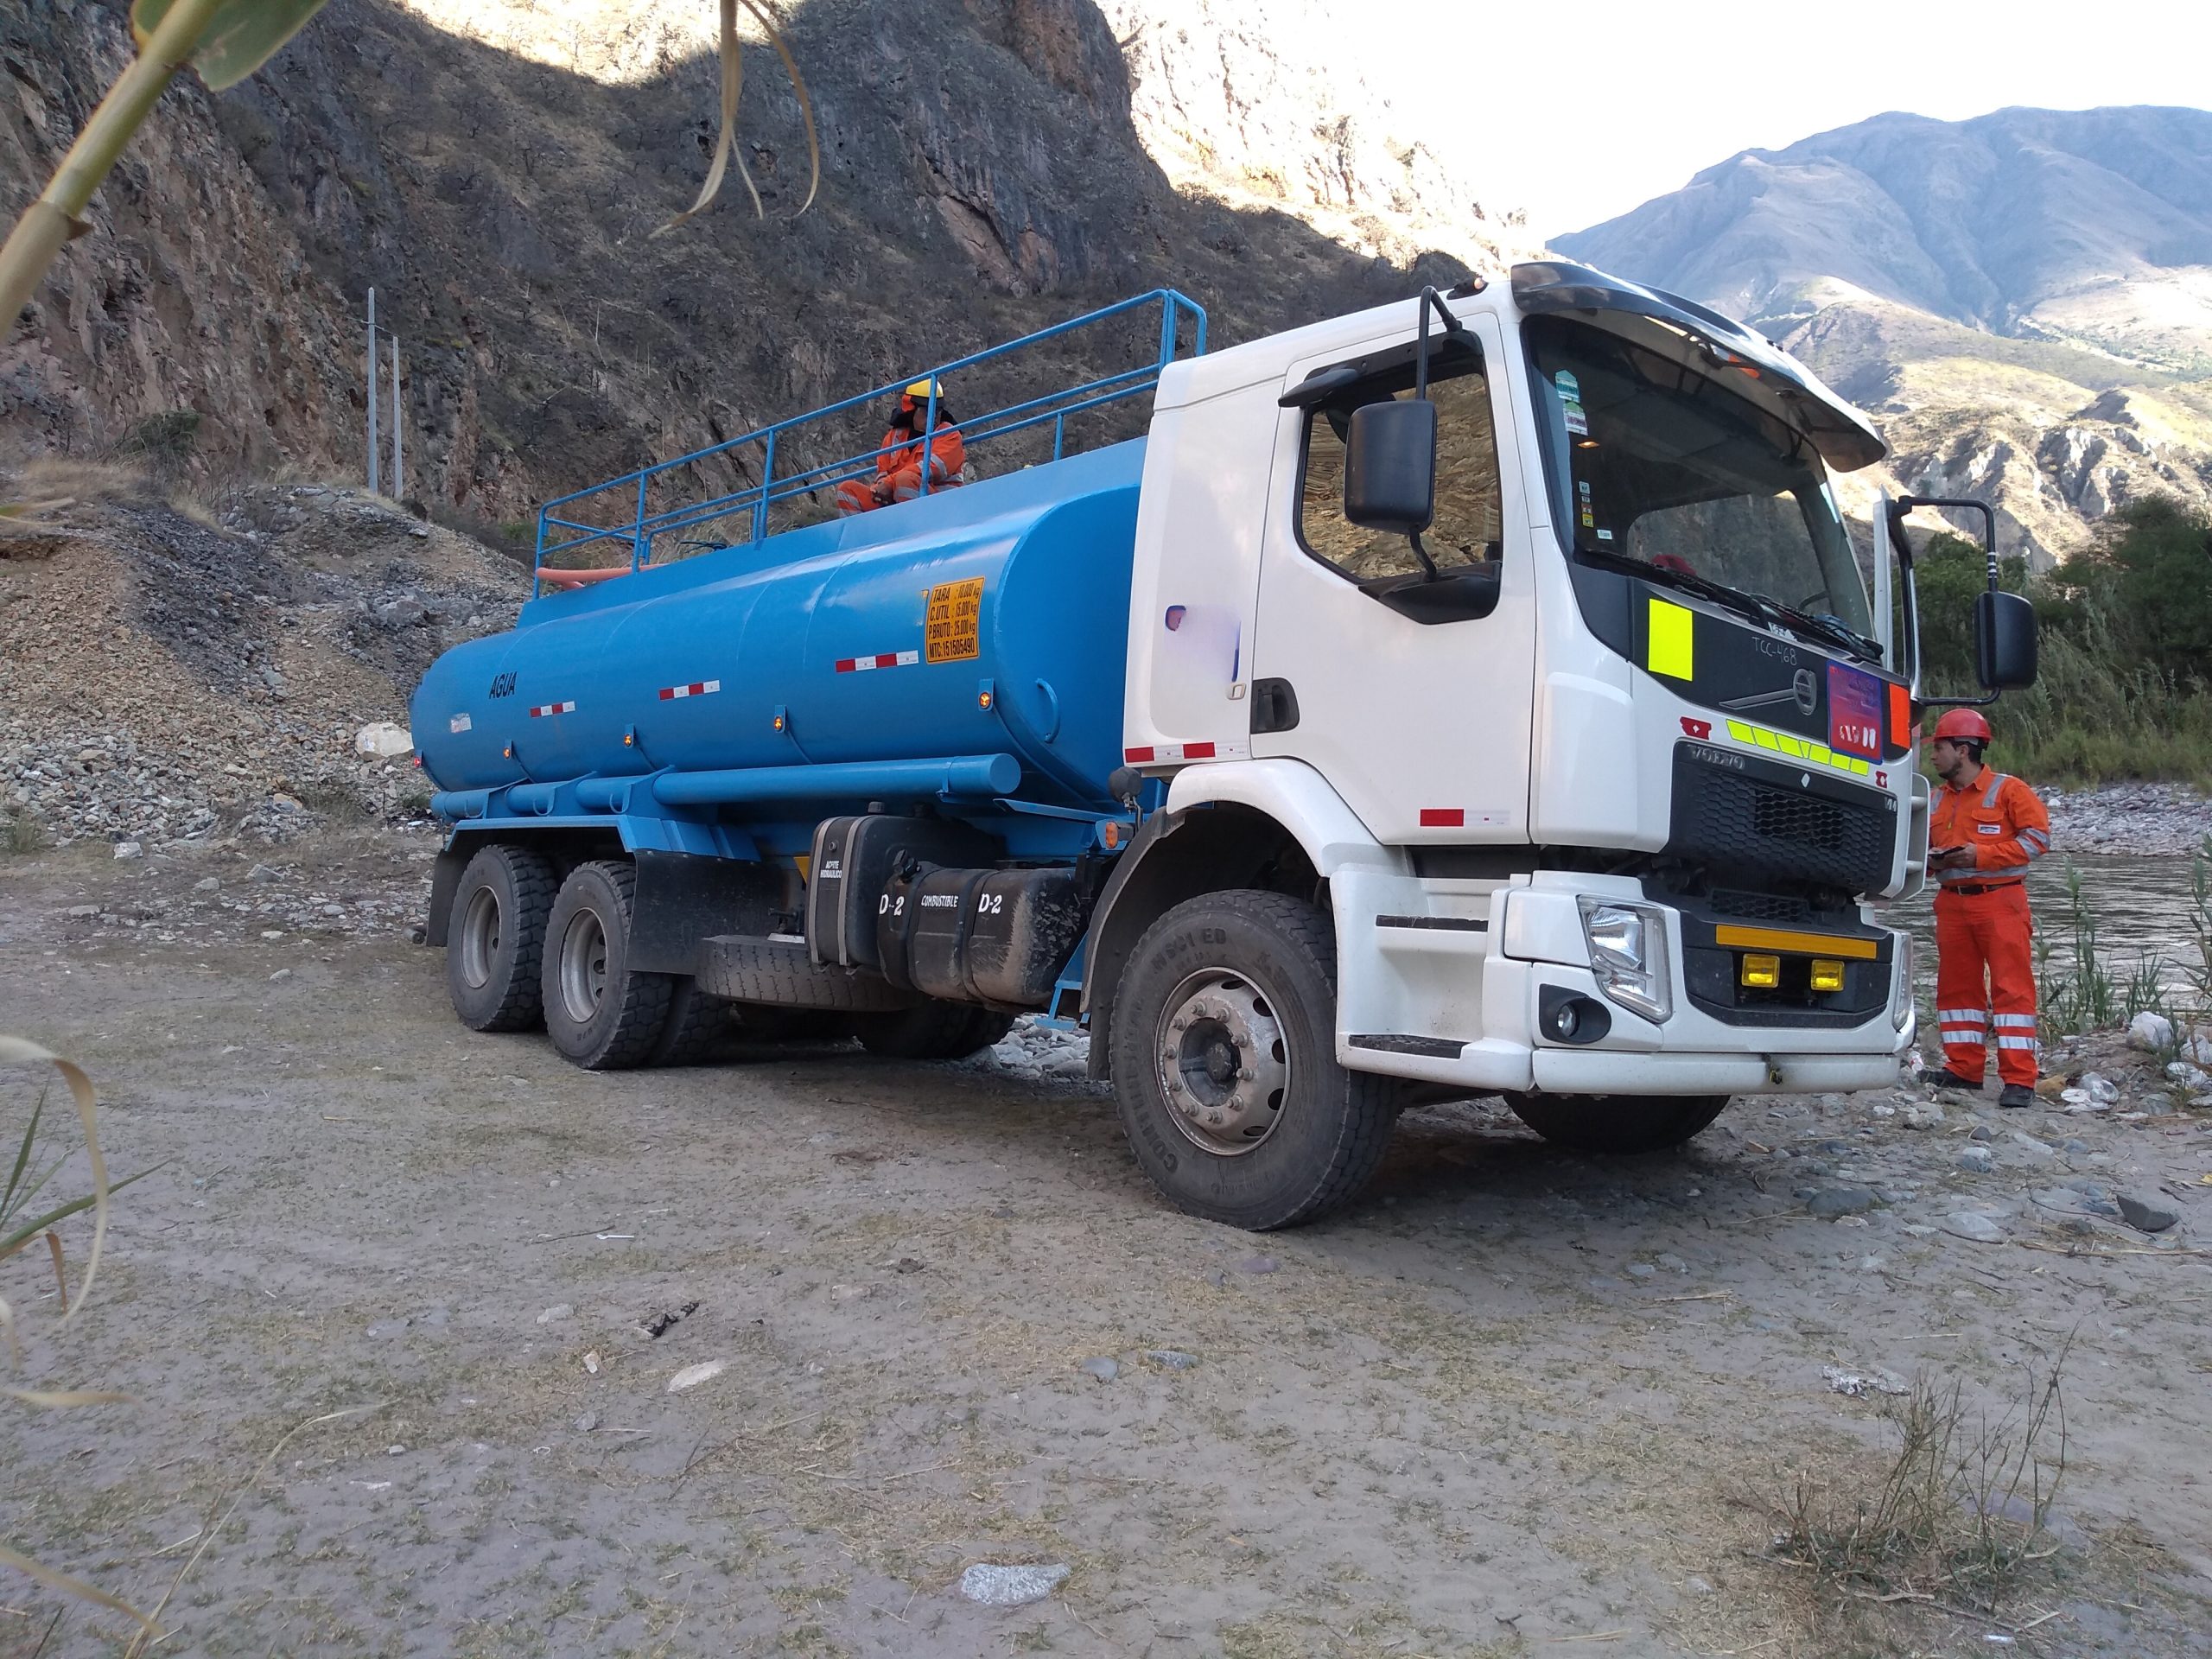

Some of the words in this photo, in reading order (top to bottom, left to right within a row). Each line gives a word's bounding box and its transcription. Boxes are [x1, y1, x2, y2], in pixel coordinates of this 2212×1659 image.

[933, 588, 950, 603] TARA
[930, 604, 950, 621] C.UTIL
[970, 602, 977, 616] kg
[969, 620, 976, 635] kg
[1751, 636, 1797, 666] TCC-468
[488, 671, 518, 700] AGUA
[879, 893, 906, 916] D-2
[920, 893, 959, 908] COMBUSTIBLE
[977, 893, 1003, 915] D-2
